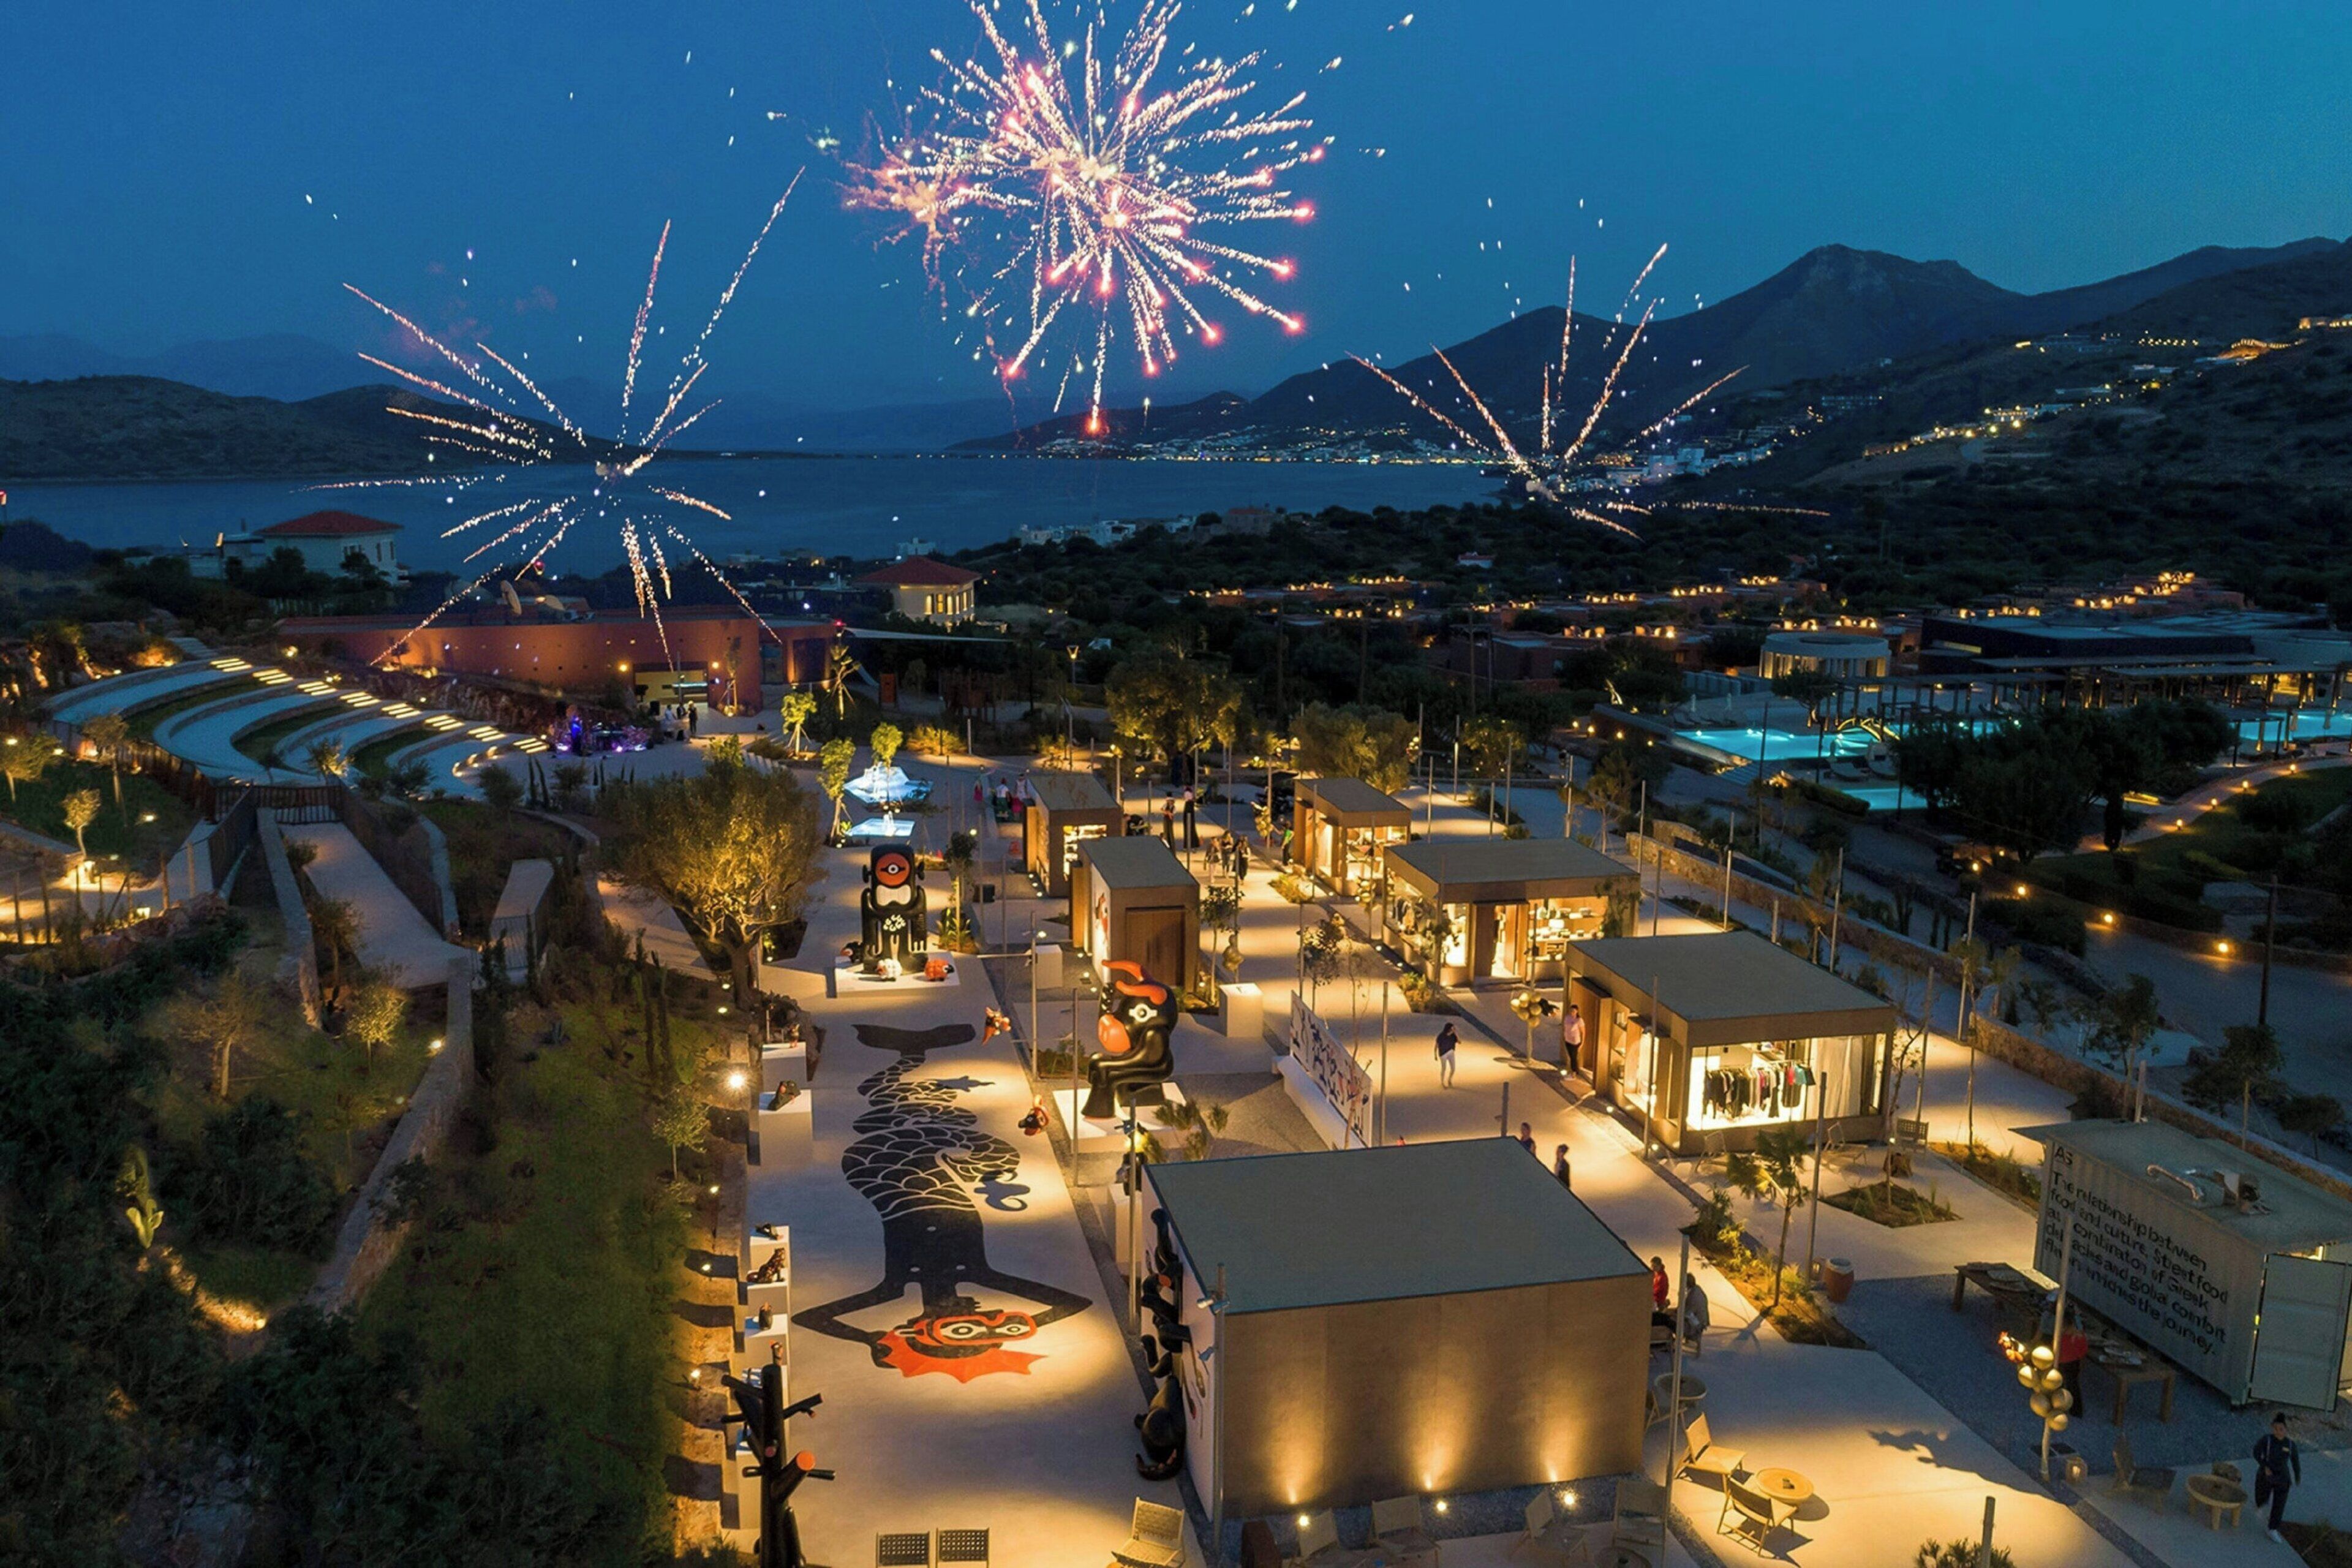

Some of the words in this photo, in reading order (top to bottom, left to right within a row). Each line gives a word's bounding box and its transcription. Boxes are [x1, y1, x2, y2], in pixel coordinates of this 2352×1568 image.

[2051, 1188, 2076, 1212] food
[2153, 1248, 2195, 1284] Street
[2196, 1275, 2228, 1305] food
[2149, 1226, 2207, 1272] between
[2103, 1260, 2128, 1281] and
[2172, 1301, 2226, 1343] comfort
[2151, 1269, 2166, 1284] of
[2167, 1275, 2209, 1311] Greek
